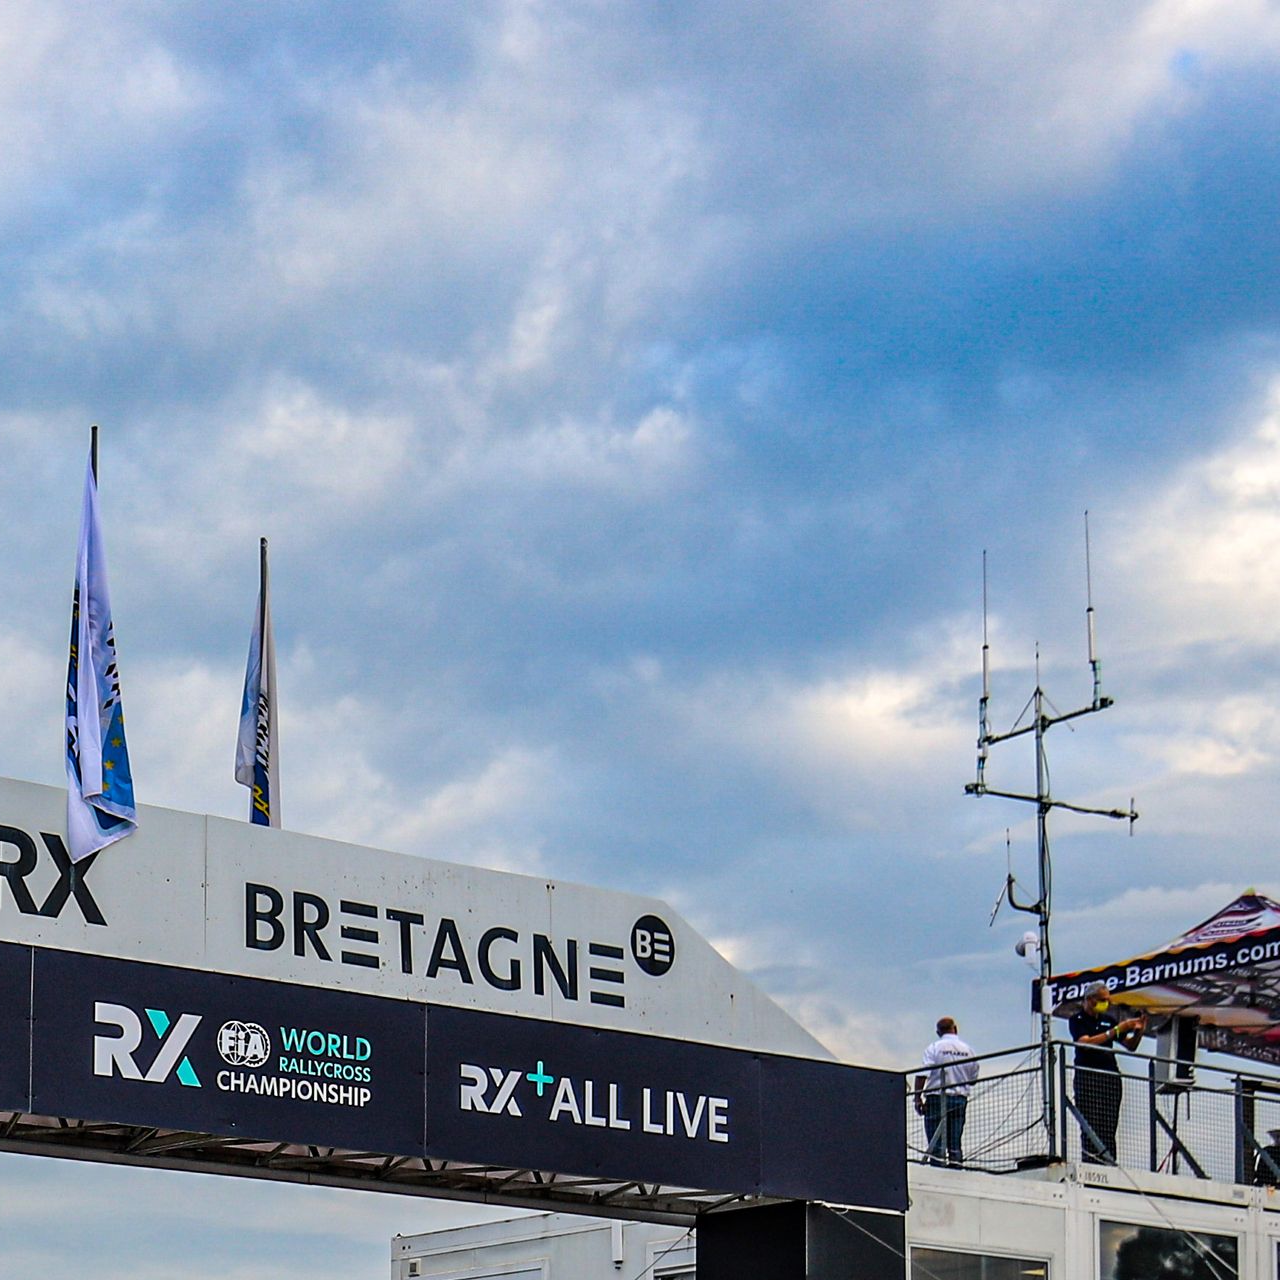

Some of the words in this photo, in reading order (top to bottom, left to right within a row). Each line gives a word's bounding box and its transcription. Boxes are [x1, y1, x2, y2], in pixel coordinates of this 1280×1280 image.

[244, 881, 626, 1008] BRETAGNE
[93, 1001, 203, 1088] RX
[279, 1026, 371, 1061] WORLD
[216, 1070, 371, 1107] CHAMPIONSHIP
[278, 1056, 371, 1083] RALLYCROSS
[643, 1087, 729, 1144] LIVE
